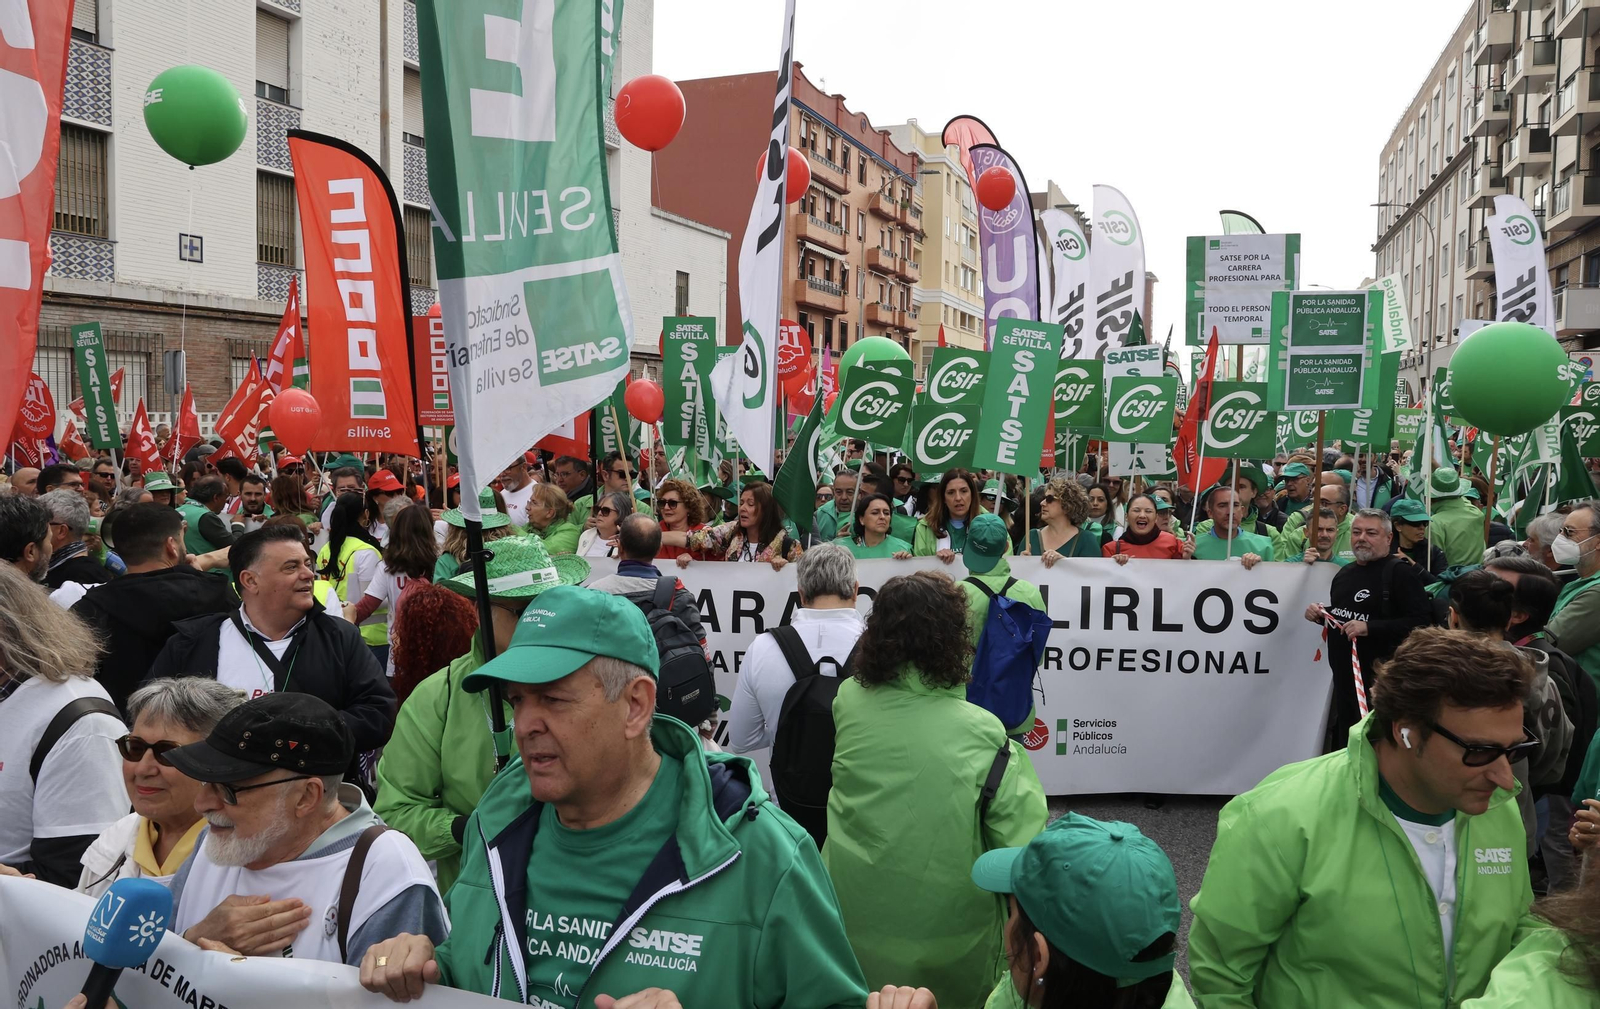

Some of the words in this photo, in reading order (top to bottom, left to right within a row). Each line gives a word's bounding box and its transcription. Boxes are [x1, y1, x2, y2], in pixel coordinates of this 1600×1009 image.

[1219, 254, 1242, 262] SATSE
[1260, 253, 1271, 261] LA
[1227, 264, 1262, 272] CARRERA
[1208, 274, 1259, 282] PROFESIONAL
[1260, 273, 1282, 281] PARA
[1208, 305, 1230, 313] TODO
[1241, 304, 1271, 312] PERSON
[1327, 298, 1356, 306] SANIDAD
[1296, 306, 1325, 315] PÚBLICA
[1223, 315, 1264, 323] TEMPORAL
[669, 331, 710, 340] SEVILLA
[675, 324, 704, 332] SATSE
[1011, 327, 1047, 341] SATSE
[76, 336, 100, 348] SEVILLA
[1002, 335, 1053, 351] SEVILLA
[1106, 348, 1160, 365] SATSE
[1323, 358, 1353, 366] SANIDAD
[1293, 366, 1322, 374] PÚBLICA
[1322, 366, 1358, 374] ANDALUZA
[940, 370, 984, 390] CSIF
[84, 348, 111, 442] SATSE
[1054, 383, 1096, 402] CSIF
[854, 394, 904, 419] CSIF
[995, 350, 1036, 465] SATSE
[1121, 399, 1168, 418] CSIF
[1214, 409, 1268, 429] CSIF
[927, 428, 973, 447] CSIF
[1040, 584, 1280, 635] LIRLOS
[1043, 646, 1271, 674] ROFESIONAL
[1073, 719, 1117, 728] Servicios
[1073, 731, 1113, 741] Públicos
[1073, 743, 1128, 755] Andalucía
[1474, 847, 1512, 863] SATSE
[628, 926, 704, 957] SATSE
[624, 951, 698, 972] ANDALUCÍA
[150, 957, 177, 989] DE
